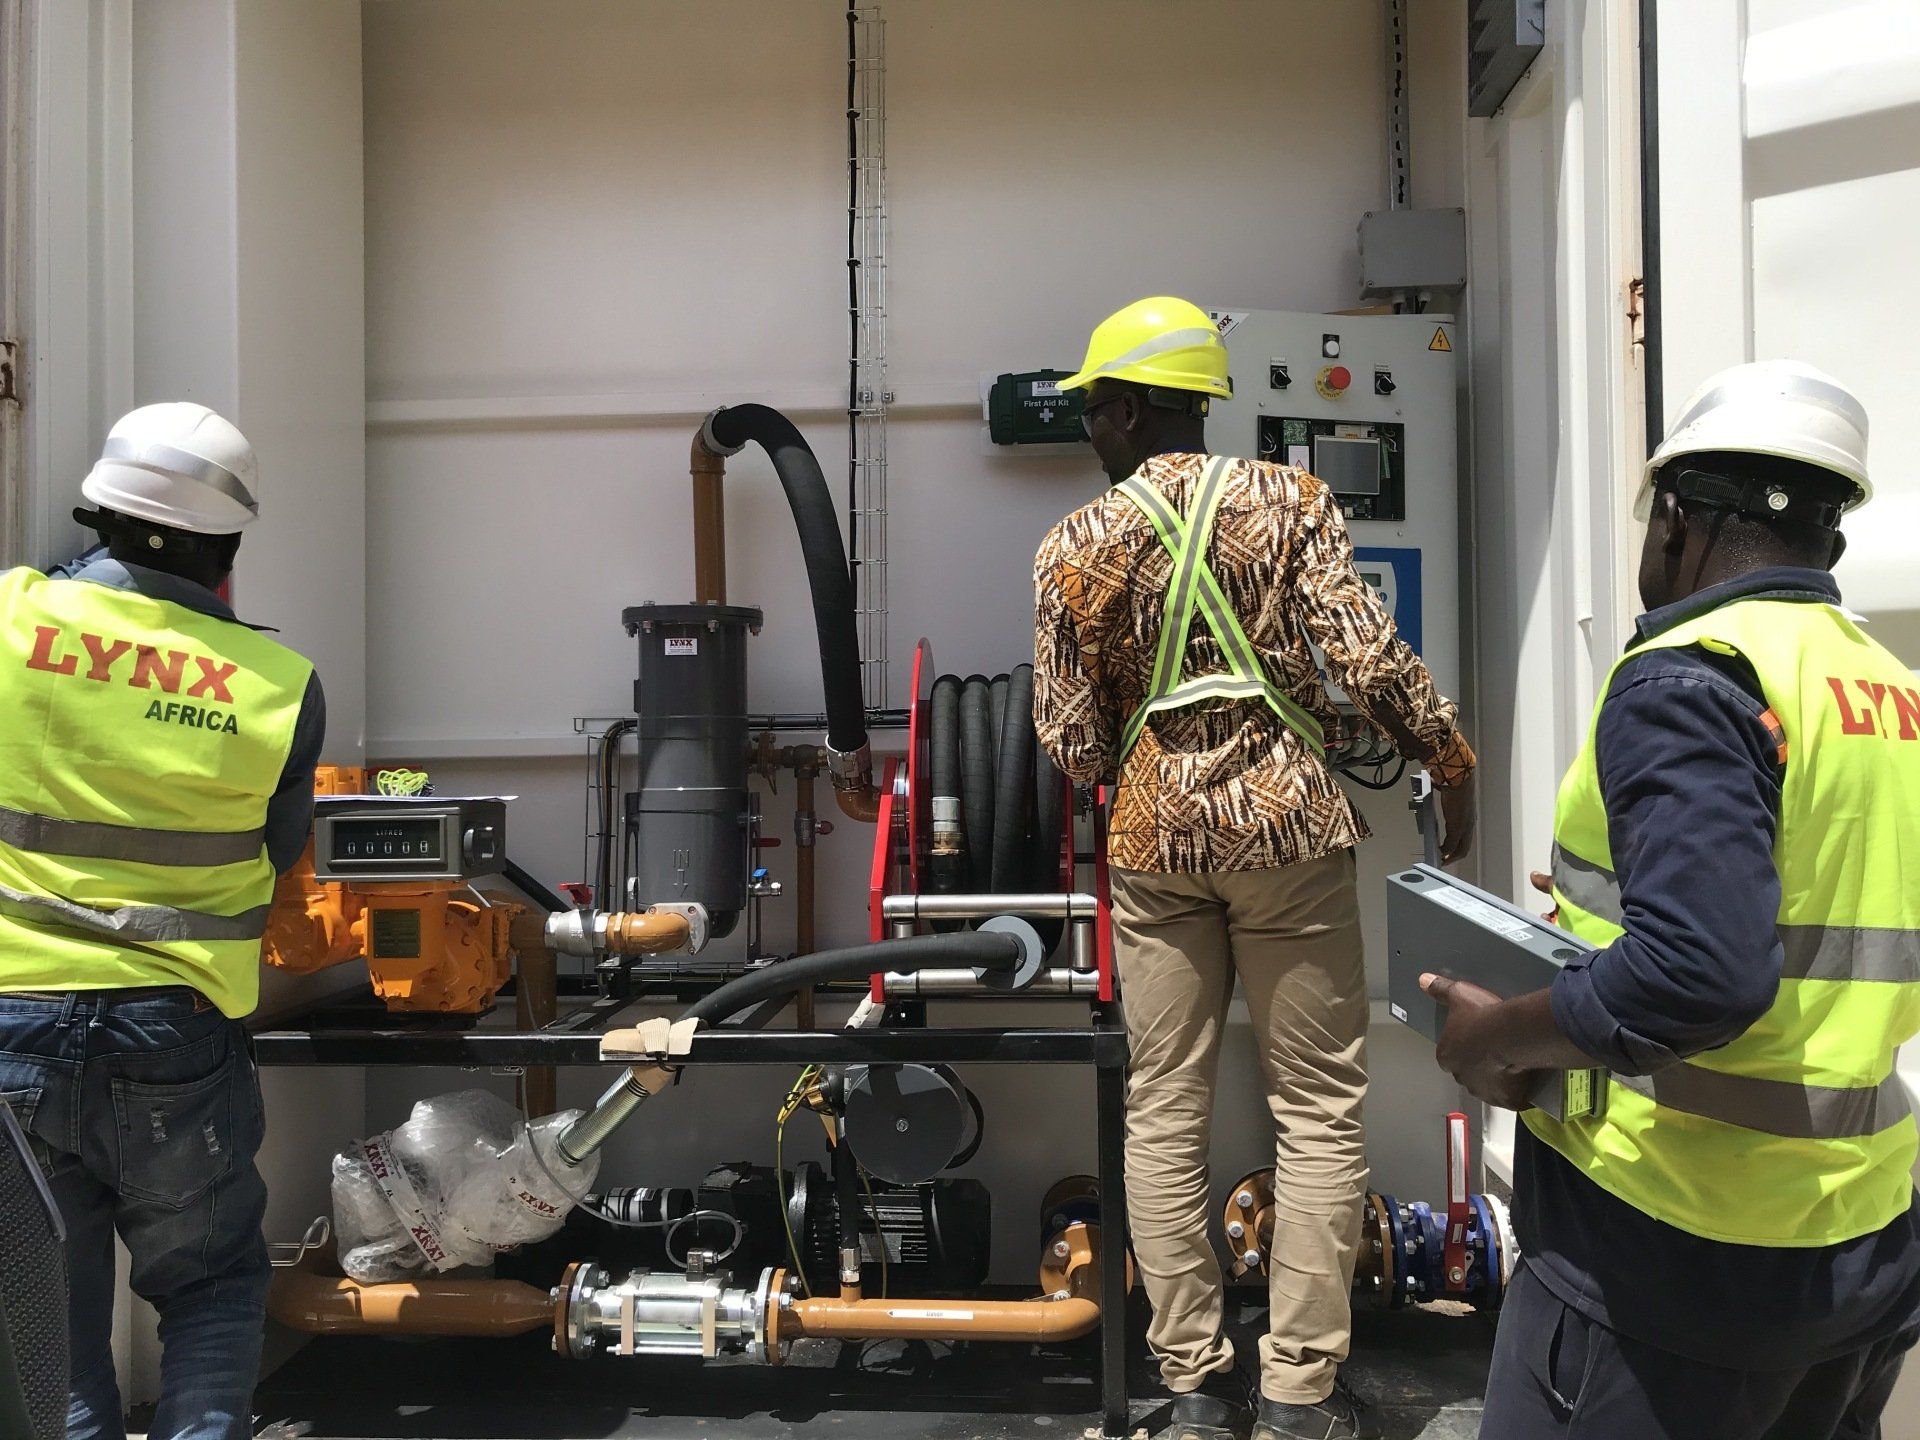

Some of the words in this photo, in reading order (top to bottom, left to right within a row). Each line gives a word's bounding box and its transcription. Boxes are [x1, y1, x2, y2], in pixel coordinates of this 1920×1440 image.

[1058, 399, 1069, 407] Kit
[669, 639, 693, 647] LYNX
[26, 625, 238, 704] LYNX
[144, 699, 238, 735] AFRICA
[364, 1143, 389, 1180] LYNX
[518, 1190, 561, 1214] LYNX
[411, 1225, 446, 1263] LYNX
